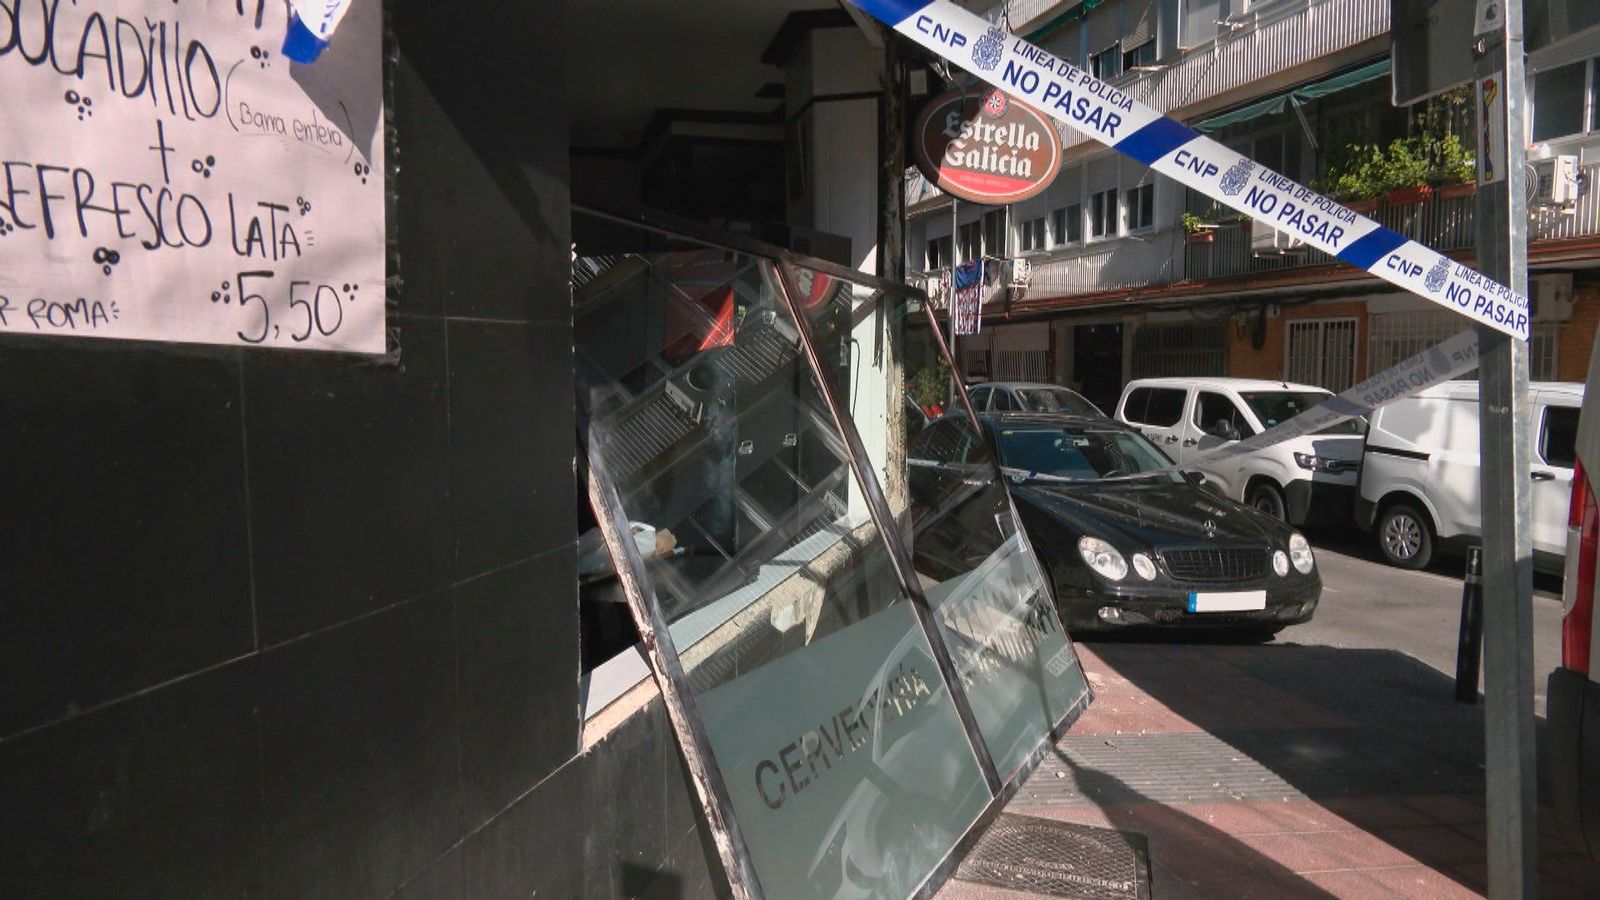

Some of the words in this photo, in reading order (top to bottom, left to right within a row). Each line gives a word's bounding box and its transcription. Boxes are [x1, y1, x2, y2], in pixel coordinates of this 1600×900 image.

[916, 14, 967, 48] CNP
[1013, 40, 1056, 72] LINEA
[1057, 63, 1080, 83] DE
[1002, 60, 1040, 95] NO
[1042, 81, 1122, 138] PASAR
[942, 111, 1040, 152] Estrella
[945, 138, 1032, 178] Galicia
[1174, 150, 1219, 178] CNP
[0, 162, 212, 250] EFRESCO
[1258, 168, 1293, 195] LINEA
[1294, 185, 1315, 204] DE
[229, 193, 301, 261] LATA
[1244, 185, 1278, 215] NO
[1277, 201, 1344, 248] PASAR
[1387, 254, 1423, 278] CNP
[1455, 264, 1482, 288] LINEA
[1483, 278, 1497, 294] DE
[27, 298, 110, 329] ROMA
[237, 270, 342, 344] 5,50
[1445, 281, 1472, 308] NO
[1474, 294, 1528, 335] PASAR
